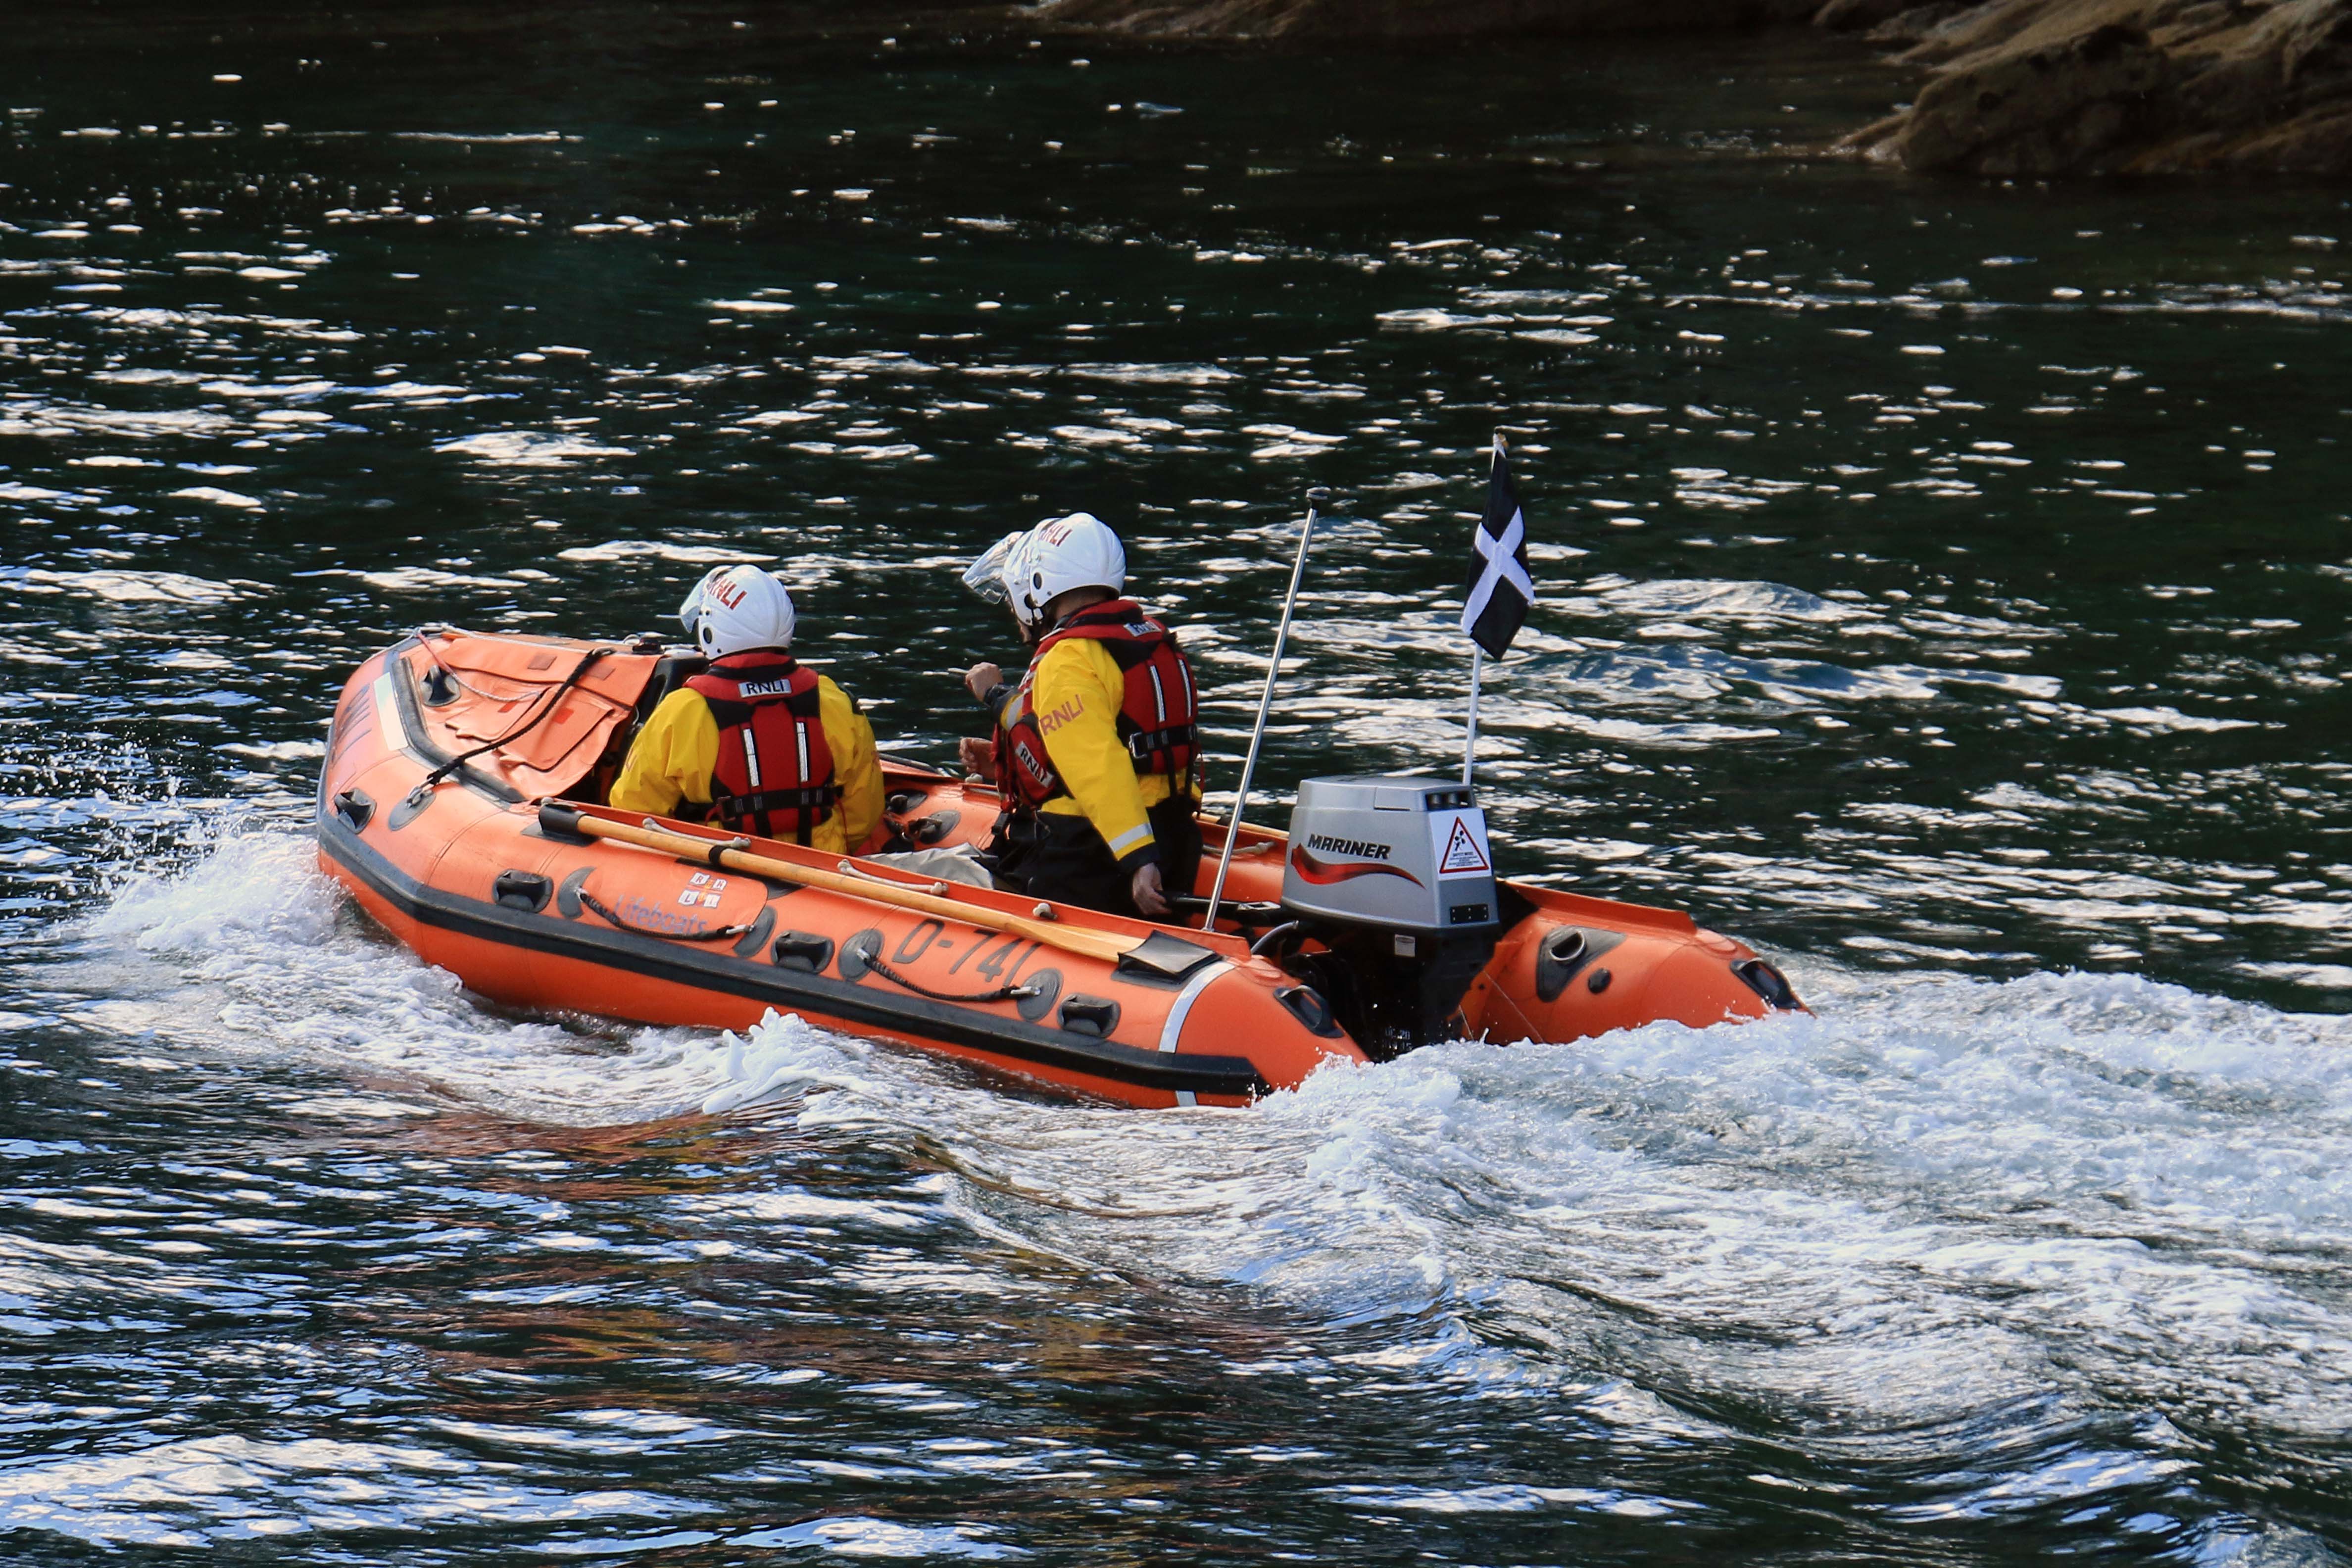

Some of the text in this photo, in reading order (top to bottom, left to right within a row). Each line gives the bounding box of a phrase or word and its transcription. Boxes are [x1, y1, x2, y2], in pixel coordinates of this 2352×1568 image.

[746, 681, 784, 694] RNLI
[1040, 694, 1083, 735] RNLI
[1308, 833, 1391, 860] MARINER
[614, 894, 707, 935] Lifeboats
[892, 919, 1043, 986] D-741
